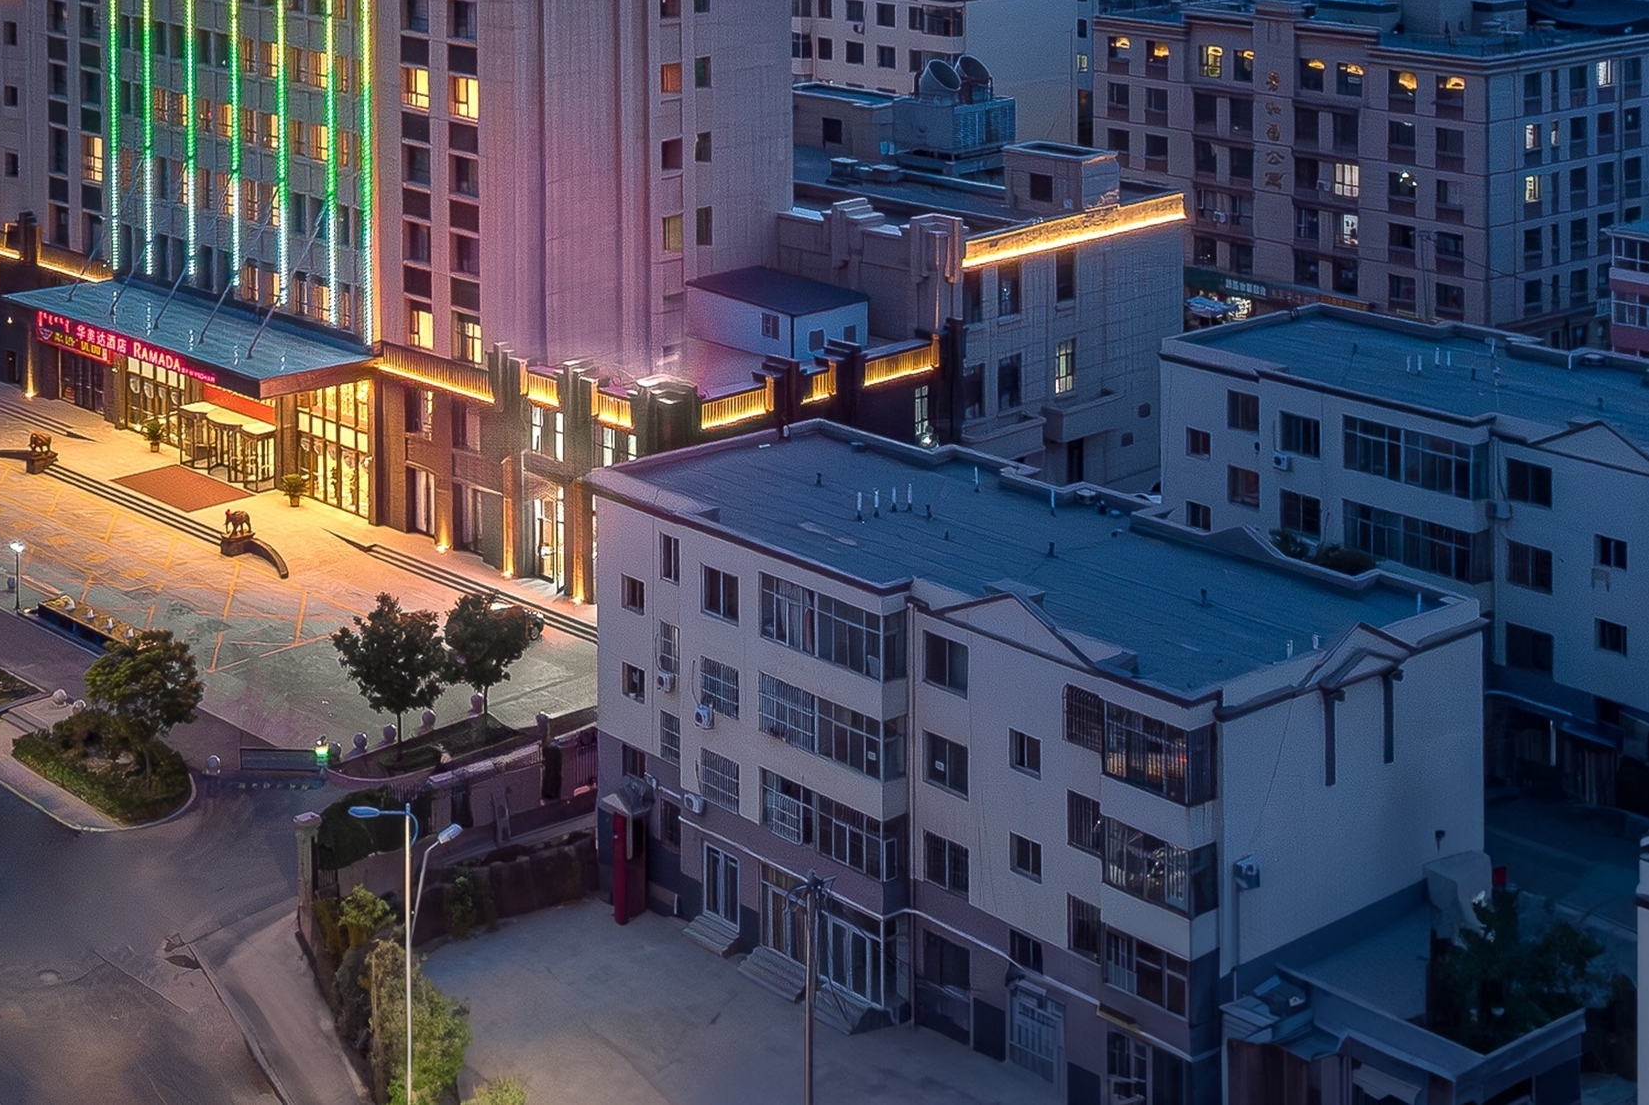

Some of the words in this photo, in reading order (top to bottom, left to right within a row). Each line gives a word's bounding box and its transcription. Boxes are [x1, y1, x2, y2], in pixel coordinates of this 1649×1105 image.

[76, 323, 127, 354] 华美达酒店
[133, 341, 182, 370] RAMADA
